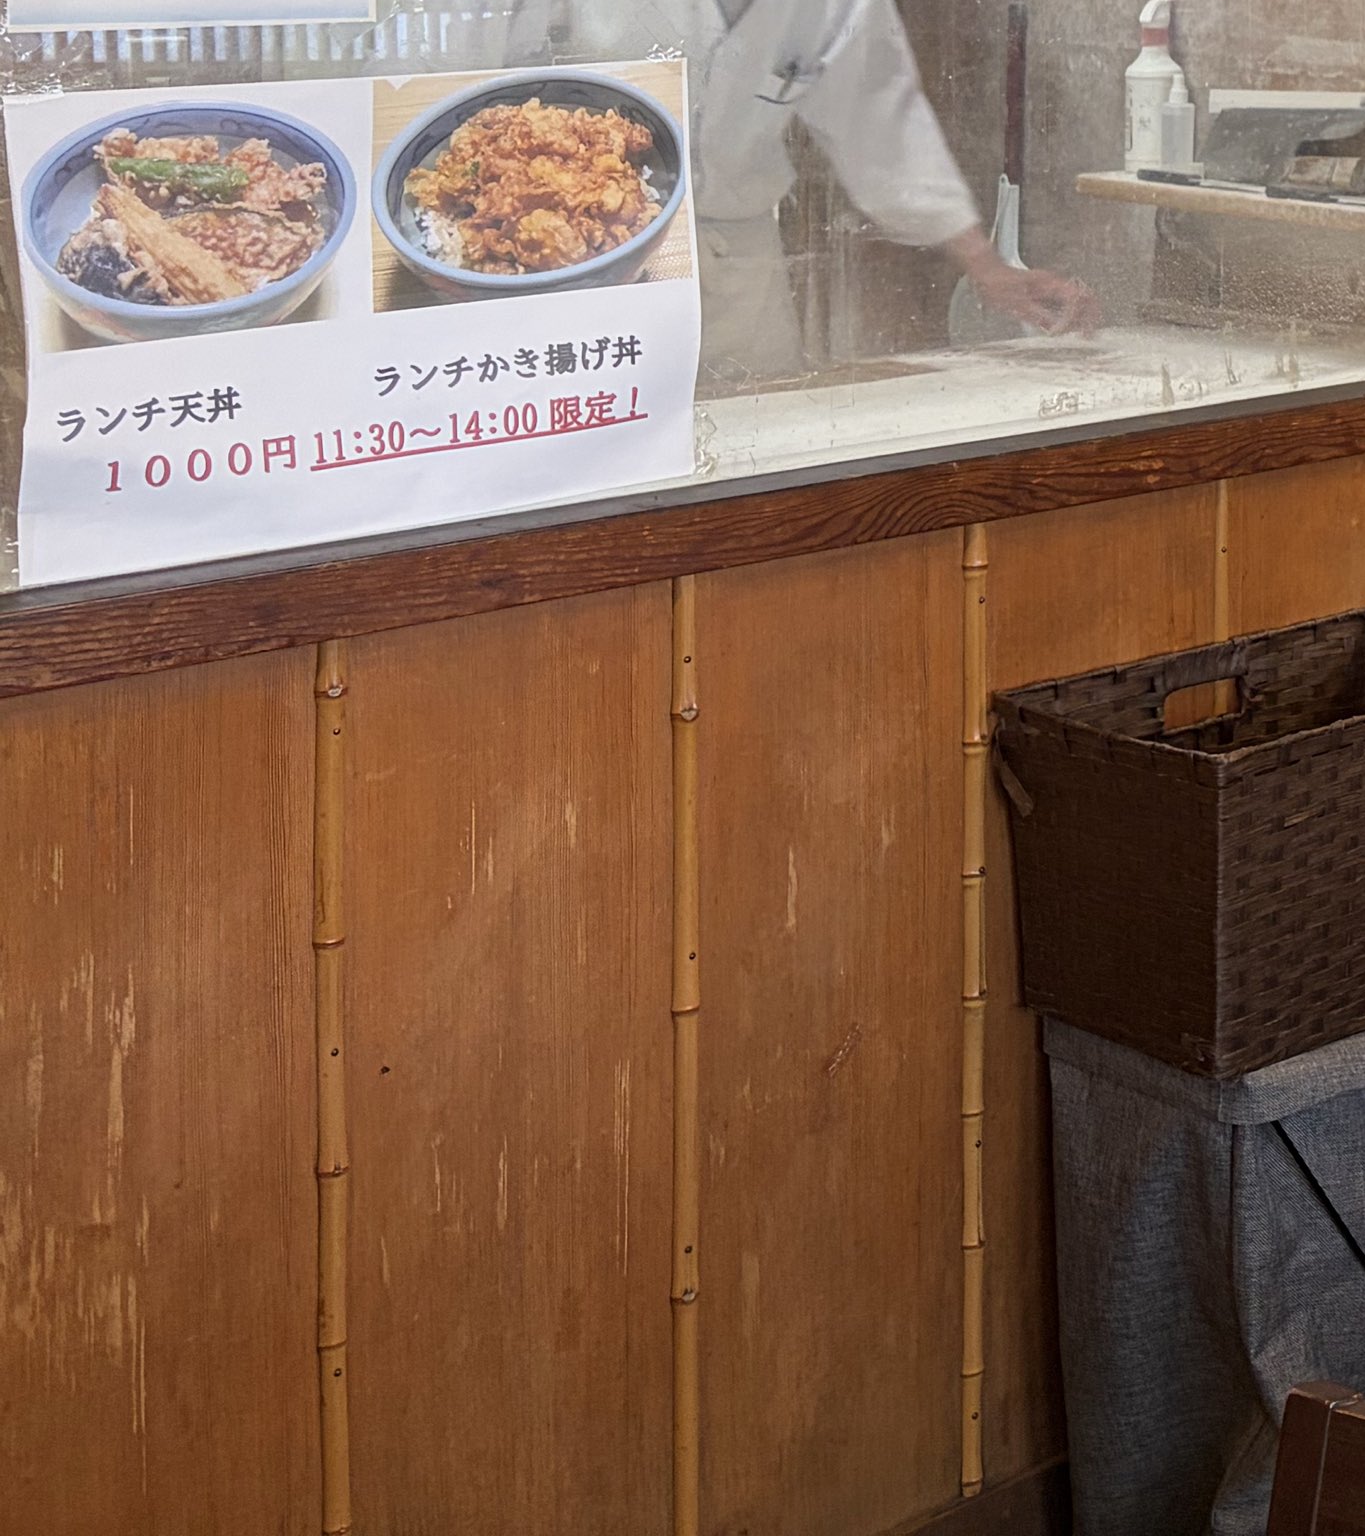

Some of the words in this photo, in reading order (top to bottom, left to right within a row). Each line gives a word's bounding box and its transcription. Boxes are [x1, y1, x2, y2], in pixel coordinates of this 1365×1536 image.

[374, 334, 643, 398] ランチかき揚げ丼
[56, 387, 242, 443] ランチ天丼
[550, 386, 645, 432] 限定！
